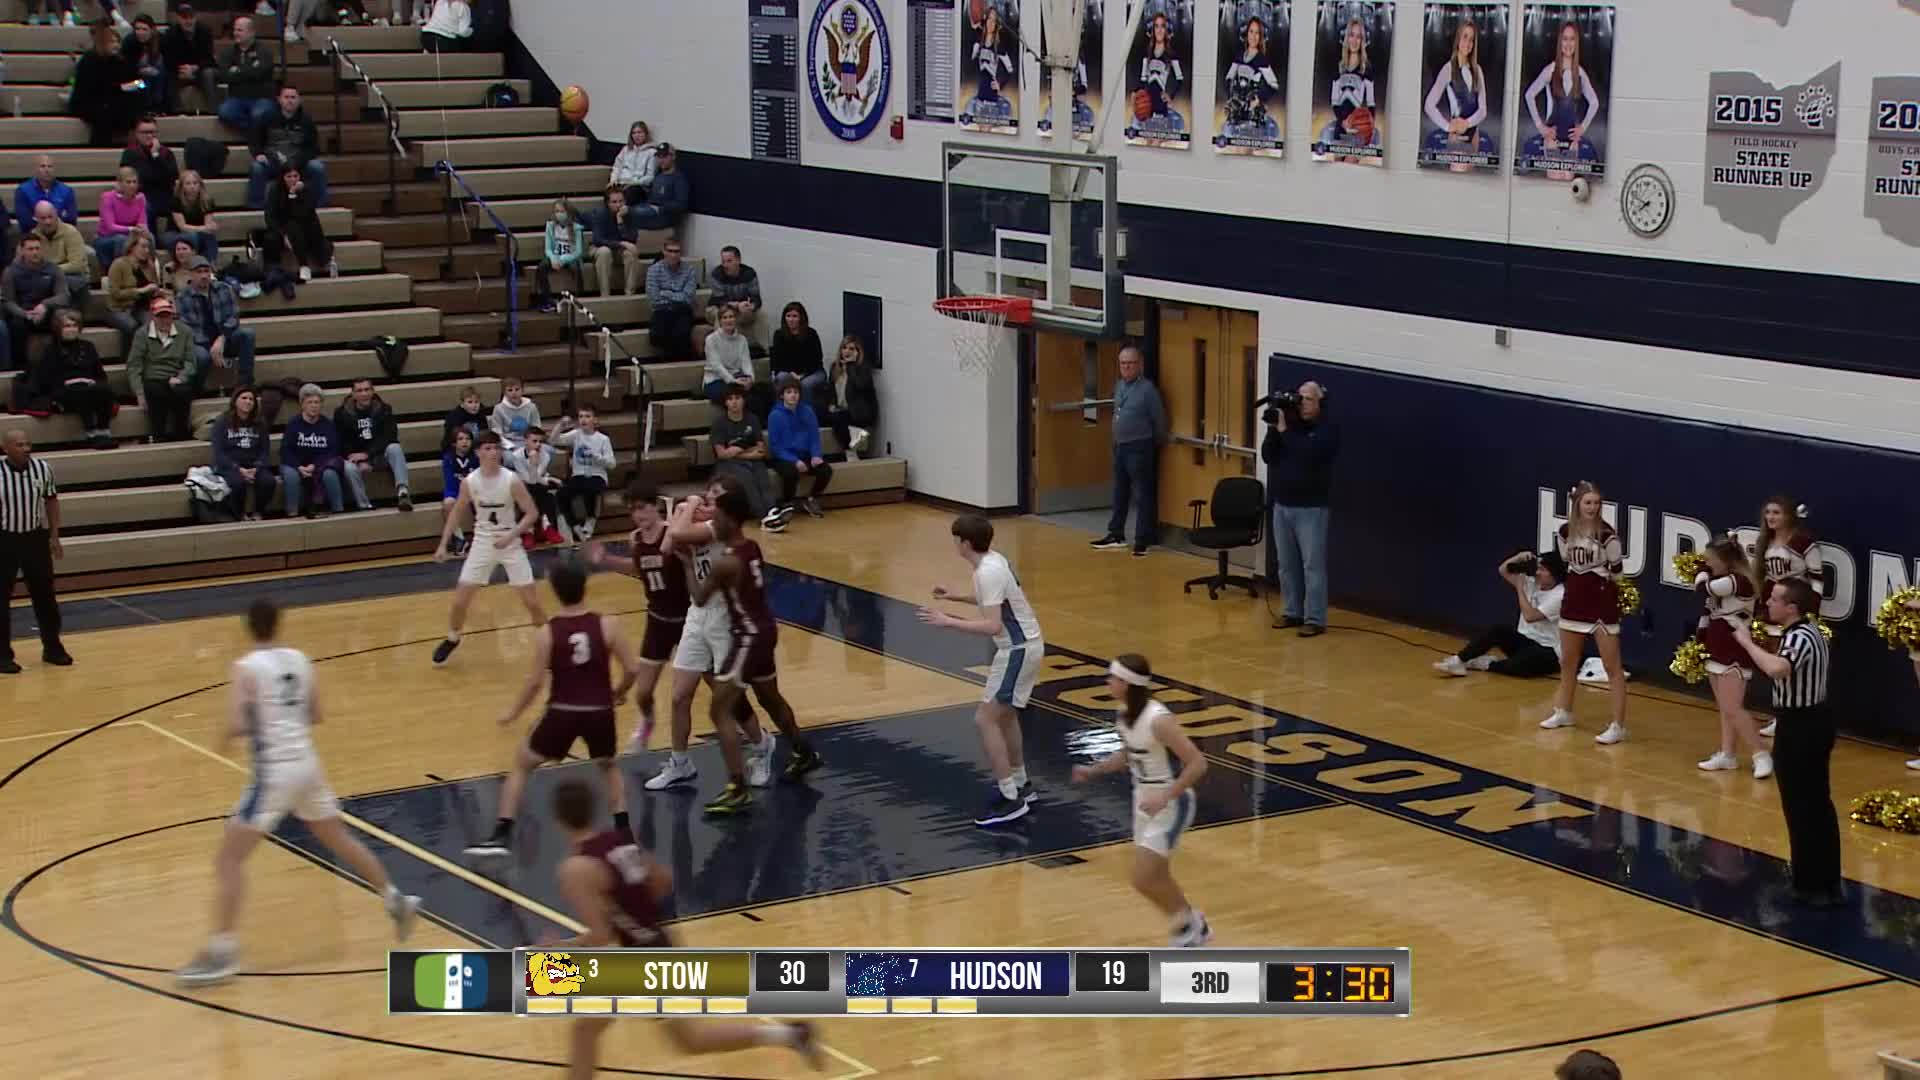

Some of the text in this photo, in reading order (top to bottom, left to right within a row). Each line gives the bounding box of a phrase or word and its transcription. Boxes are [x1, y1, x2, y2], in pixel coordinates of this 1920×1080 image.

[1715, 96, 1783, 124] 2015
[1878, 102, 1920, 131] 20
[1733, 137, 1798, 149] FIELD HOCKEY
[1879, 145, 1905, 154] BOYS
[1436, 154, 1459, 163] HUDSON
[1533, 160, 1593, 172] HUDSON EXPLORERS
[1736, 150, 1790, 168] STATE
[1713, 168, 1813, 188] RUNNER UP
[487, 511, 498, 526] 4
[647, 571, 665, 592] 11
[568, 631, 591, 666] 3
